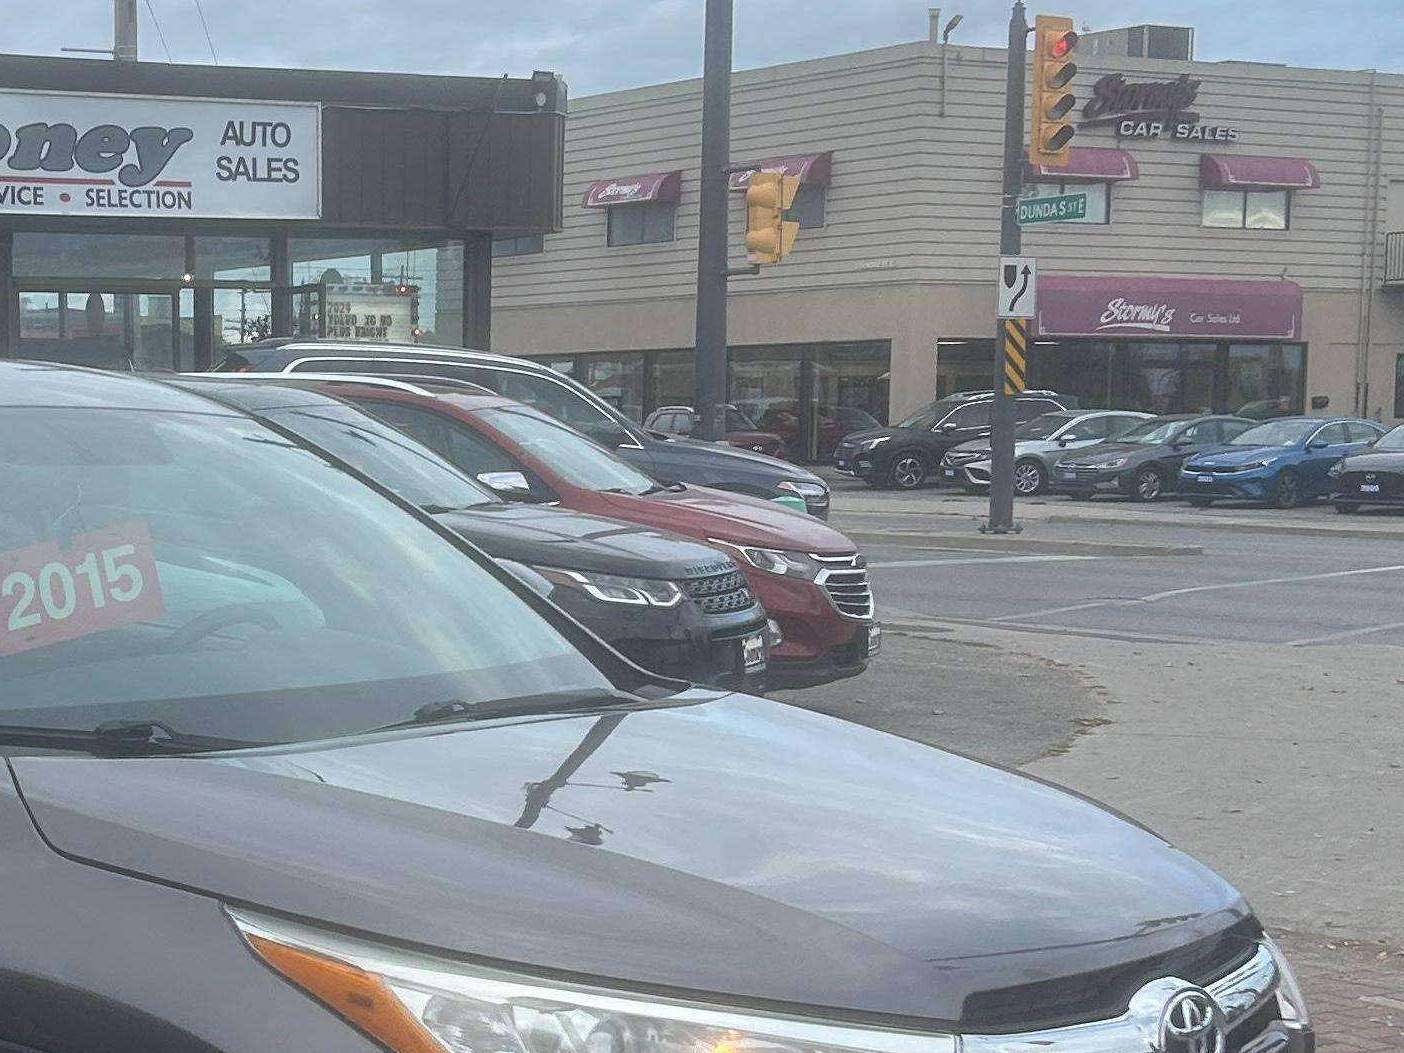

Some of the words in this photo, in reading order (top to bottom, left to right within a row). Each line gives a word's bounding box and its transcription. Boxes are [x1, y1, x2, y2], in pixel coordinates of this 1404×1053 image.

[220, 120, 292, 148] AUTO
[1120, 120, 1162, 137] CAR
[1176, 123, 1239, 141] SALES
[215, 156, 301, 184] SALES
[84, 188, 193, 211] SELECTION
[1020, 200, 1066, 219] DUNDAS
[1077, 198, 1085, 214] E
[2, 543, 144, 632] 2015
